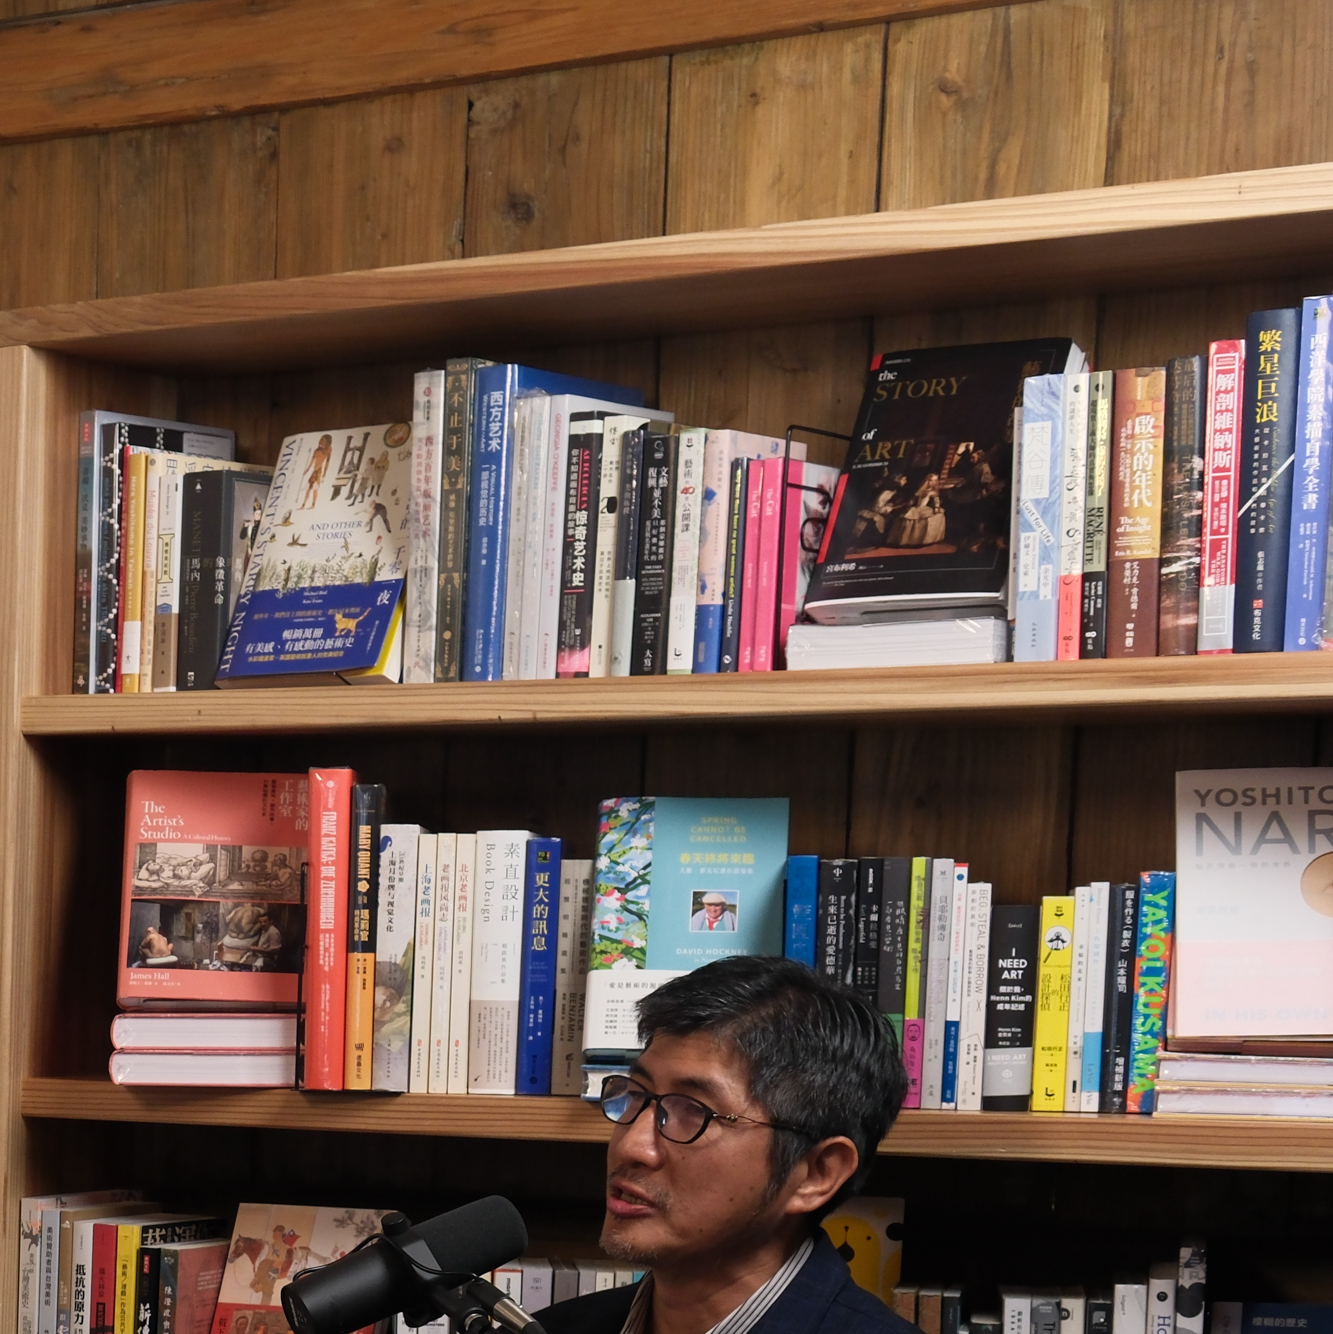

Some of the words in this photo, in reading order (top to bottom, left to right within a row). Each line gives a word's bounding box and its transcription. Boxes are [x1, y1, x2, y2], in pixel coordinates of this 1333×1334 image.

[873, 376, 968, 402] STORY
[878, 370, 898, 381] the
[1255, 330, 1283, 423] 繁星巨浪
[487, 391, 504, 452] 西方艺术
[861, 428, 878, 441] of
[1213, 373, 1235, 469] 解剖維納斯
[854, 439, 914, 463] ART
[1024, 425, 1049, 496] 梵谷傳
[308, 522, 329, 531] AND
[331, 520, 363, 530] OTHER
[315, 530, 353, 540] STORIES
[1022, 499, 1036, 521] Lust
[1039, 525, 1053, 545] Life
[1085, 507, 1095, 566] MAGRITTE
[1119, 516, 1134, 525] The
[1135, 516, 1150, 527] Age
[1125, 523, 1151, 534] Insight
[571, 509, 589, 587] 惊奇艺术史
[239, 538, 266, 606] STARRY
[220, 612, 246, 672] NIGHT
[140, 814, 185, 827] Artist's
[141, 801, 166, 814] The
[701, 816, 738, 824] SPRING
[139, 827, 182, 840] Studio
[322, 811, 337, 836] FRANZ
[358, 825, 372, 849] MARY
[689, 834, 747, 842] CANCELLED
[690, 825, 731, 833] CANNOT
[357, 850, 371, 880] QUANT
[484, 843, 496, 875] Book
[420, 863, 433, 918] 上海老画报
[457, 863, 469, 912] 北京老画报
[501, 842, 521, 922] 素直設計
[480, 881, 495, 923] Design
[531, 872, 550, 951] 更大的訊息
[978, 912, 987, 942] STEAL
[1139, 890, 1169, 968] YAYOI
[130, 972, 152, 982] James
[153, 972, 170, 981] Hall
[975, 954, 985, 994] BORROW
[998, 959, 1028, 968] NEED
[1002, 970, 1024, 979] ART
[567, 992, 578, 1043] BENJAMIN
[1132, 976, 1167, 1094] KUSAMA
[73, 1263, 87, 1326] 抵抗的原力
[1252, 1316, 1308, 1329] 模糊的歷史
